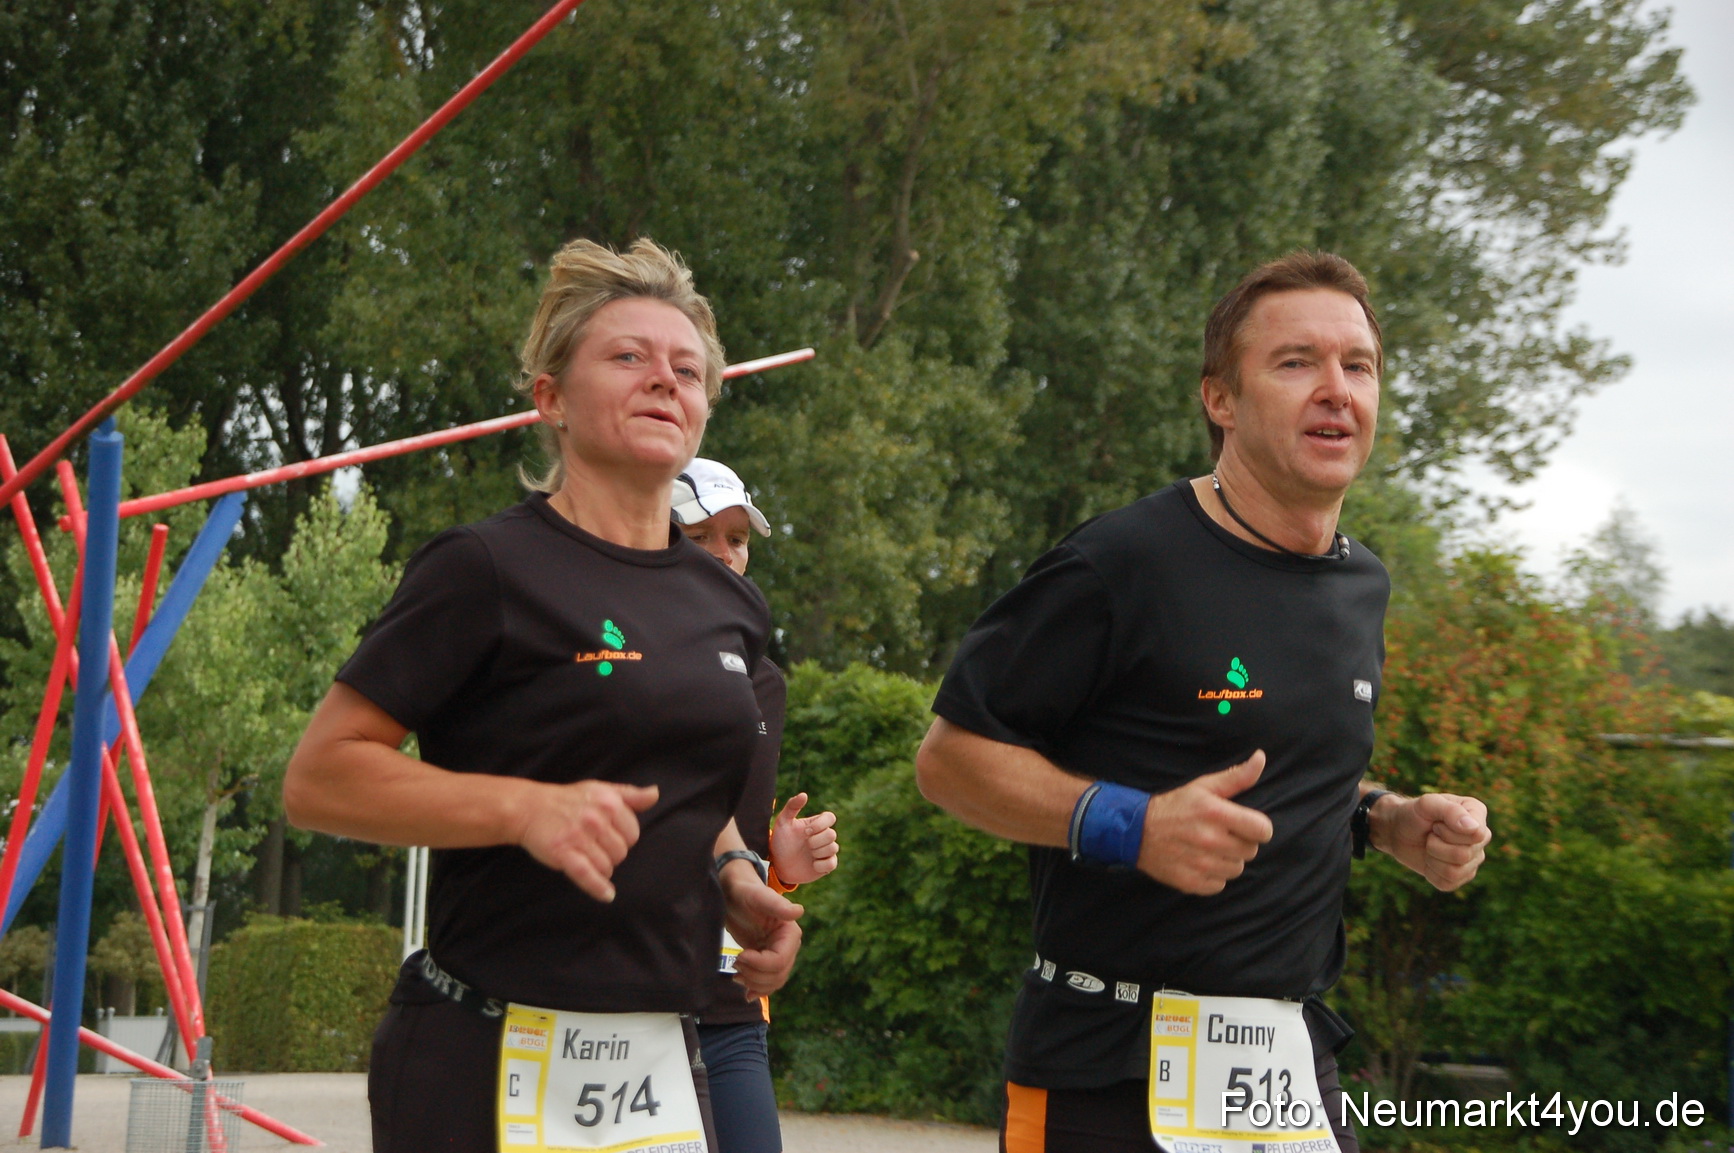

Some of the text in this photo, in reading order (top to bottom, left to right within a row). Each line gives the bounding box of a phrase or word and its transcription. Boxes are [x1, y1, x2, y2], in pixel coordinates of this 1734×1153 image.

[575, 650, 643, 663] Laufbox.de
[1198, 688, 1264, 699] Laufbox.de
[562, 1028, 631, 1061] Karin
[1207, 1013, 1276, 1053] Conny
[1159, 1060, 1171, 1082] B
[509, 1073, 520, 1097] C
[1226, 1067, 1293, 1113] 513
[574, 1074, 662, 1127] 514
[627, 1141, 704, 1153] EIDERER
